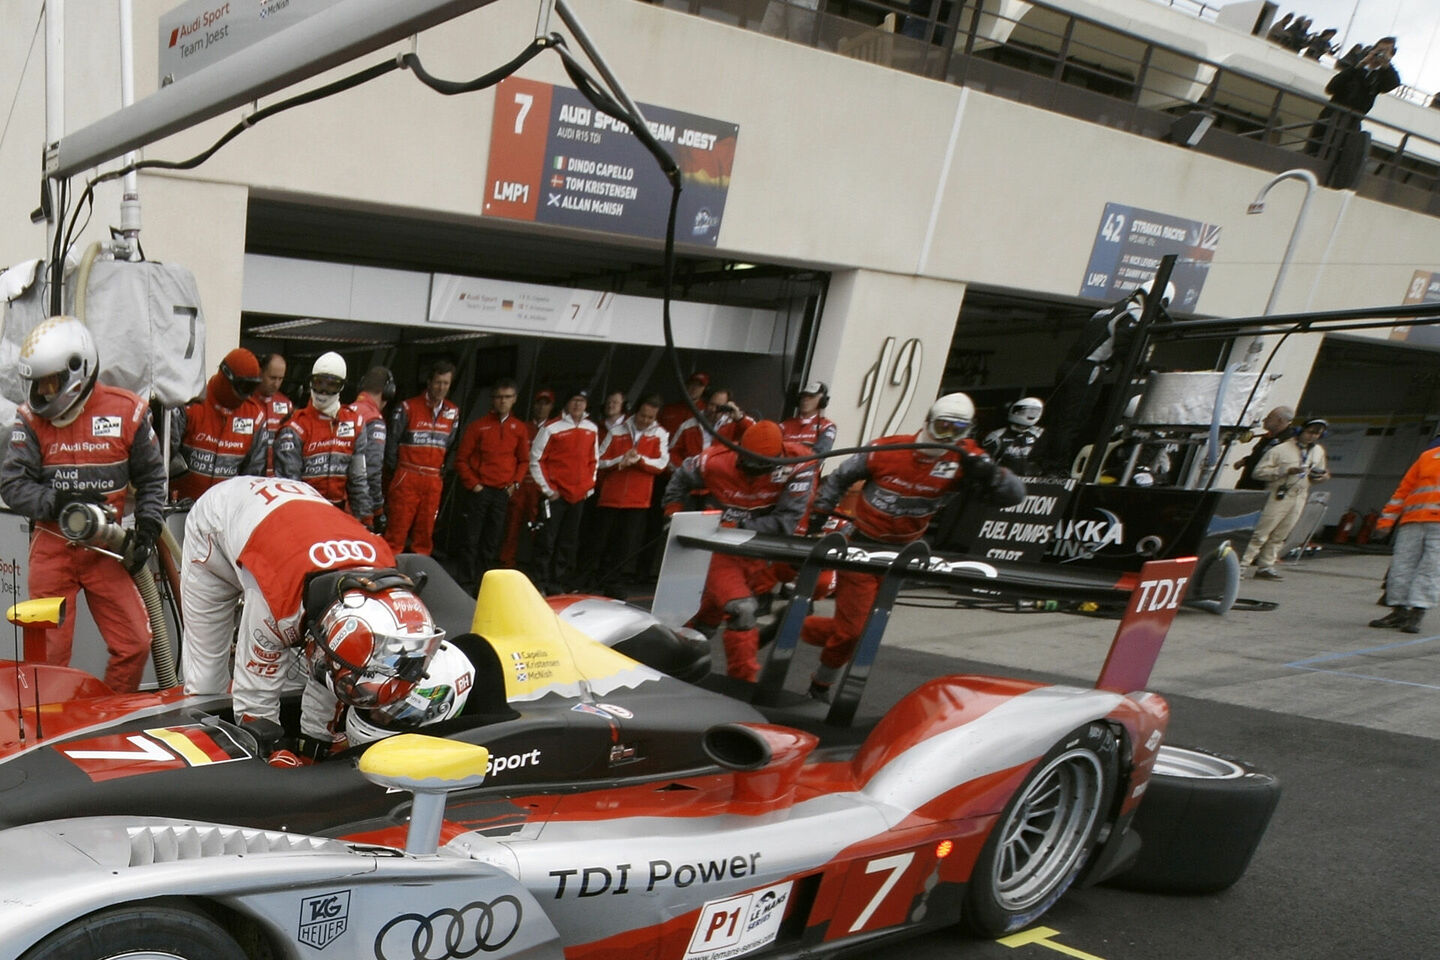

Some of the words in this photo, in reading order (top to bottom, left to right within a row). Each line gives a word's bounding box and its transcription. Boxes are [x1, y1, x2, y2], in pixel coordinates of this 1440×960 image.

[179, 16, 201, 39] Audi
[203, 3, 230, 28] Sport
[179, 37, 204, 59] Team
[205, 25, 229, 49] Joest
[514, 93, 533, 135] 7
[557, 127, 574, 139] AUDI
[575, 130, 589, 142] R15
[589, 132, 602, 144] TDI
[559, 104, 590, 127] AUDI
[594, 111, 634, 136] SPOR
[647, 122, 676, 143] EAM
[677, 129, 718, 151] JOEST
[567, 158, 595, 175] DINDO
[595, 162, 634, 181] CAPELLO
[493, 180, 530, 204] LMP1
[565, 176, 584, 192] TOM
[584, 179, 638, 200] KRISTENSEN
[561, 196, 590, 212] ALLAN
[591, 201, 624, 217] McNISH
[1101, 213, 1125, 243] 42
[1087, 272, 1108, 288] LMP2
[571, 304, 580, 320] 7
[171, 305, 198, 360] 7
[60, 442, 81, 451] Audi
[82, 442, 110, 453] Sport
[191, 450, 214, 461] Audi
[190, 459, 206, 471] Top
[208, 464, 237, 475] Servic
[50, 478, 70, 490] Top
[73, 479, 114, 490] Service
[1000, 496, 1057, 515] NITION
[979, 520, 1009, 540] FUEL
[1007, 523, 1053, 544] PUMPS
[1, 579, 21, 597] Joest
[1136, 577, 1187, 613] TDI
[63, 735, 176, 762] 7
[485, 748, 541, 777] Sport
[549, 863, 633, 899] TDI
[646, 851, 761, 893] Power
[849, 851, 915, 933] 7
[309, 896, 342, 921] TAG
[750, 909, 761, 922] LE
[762, 892, 787, 915] MANS
[301, 921, 344, 945] HEUER
[704, 907, 741, 942] P1
[746, 912, 771, 932] SERIES
